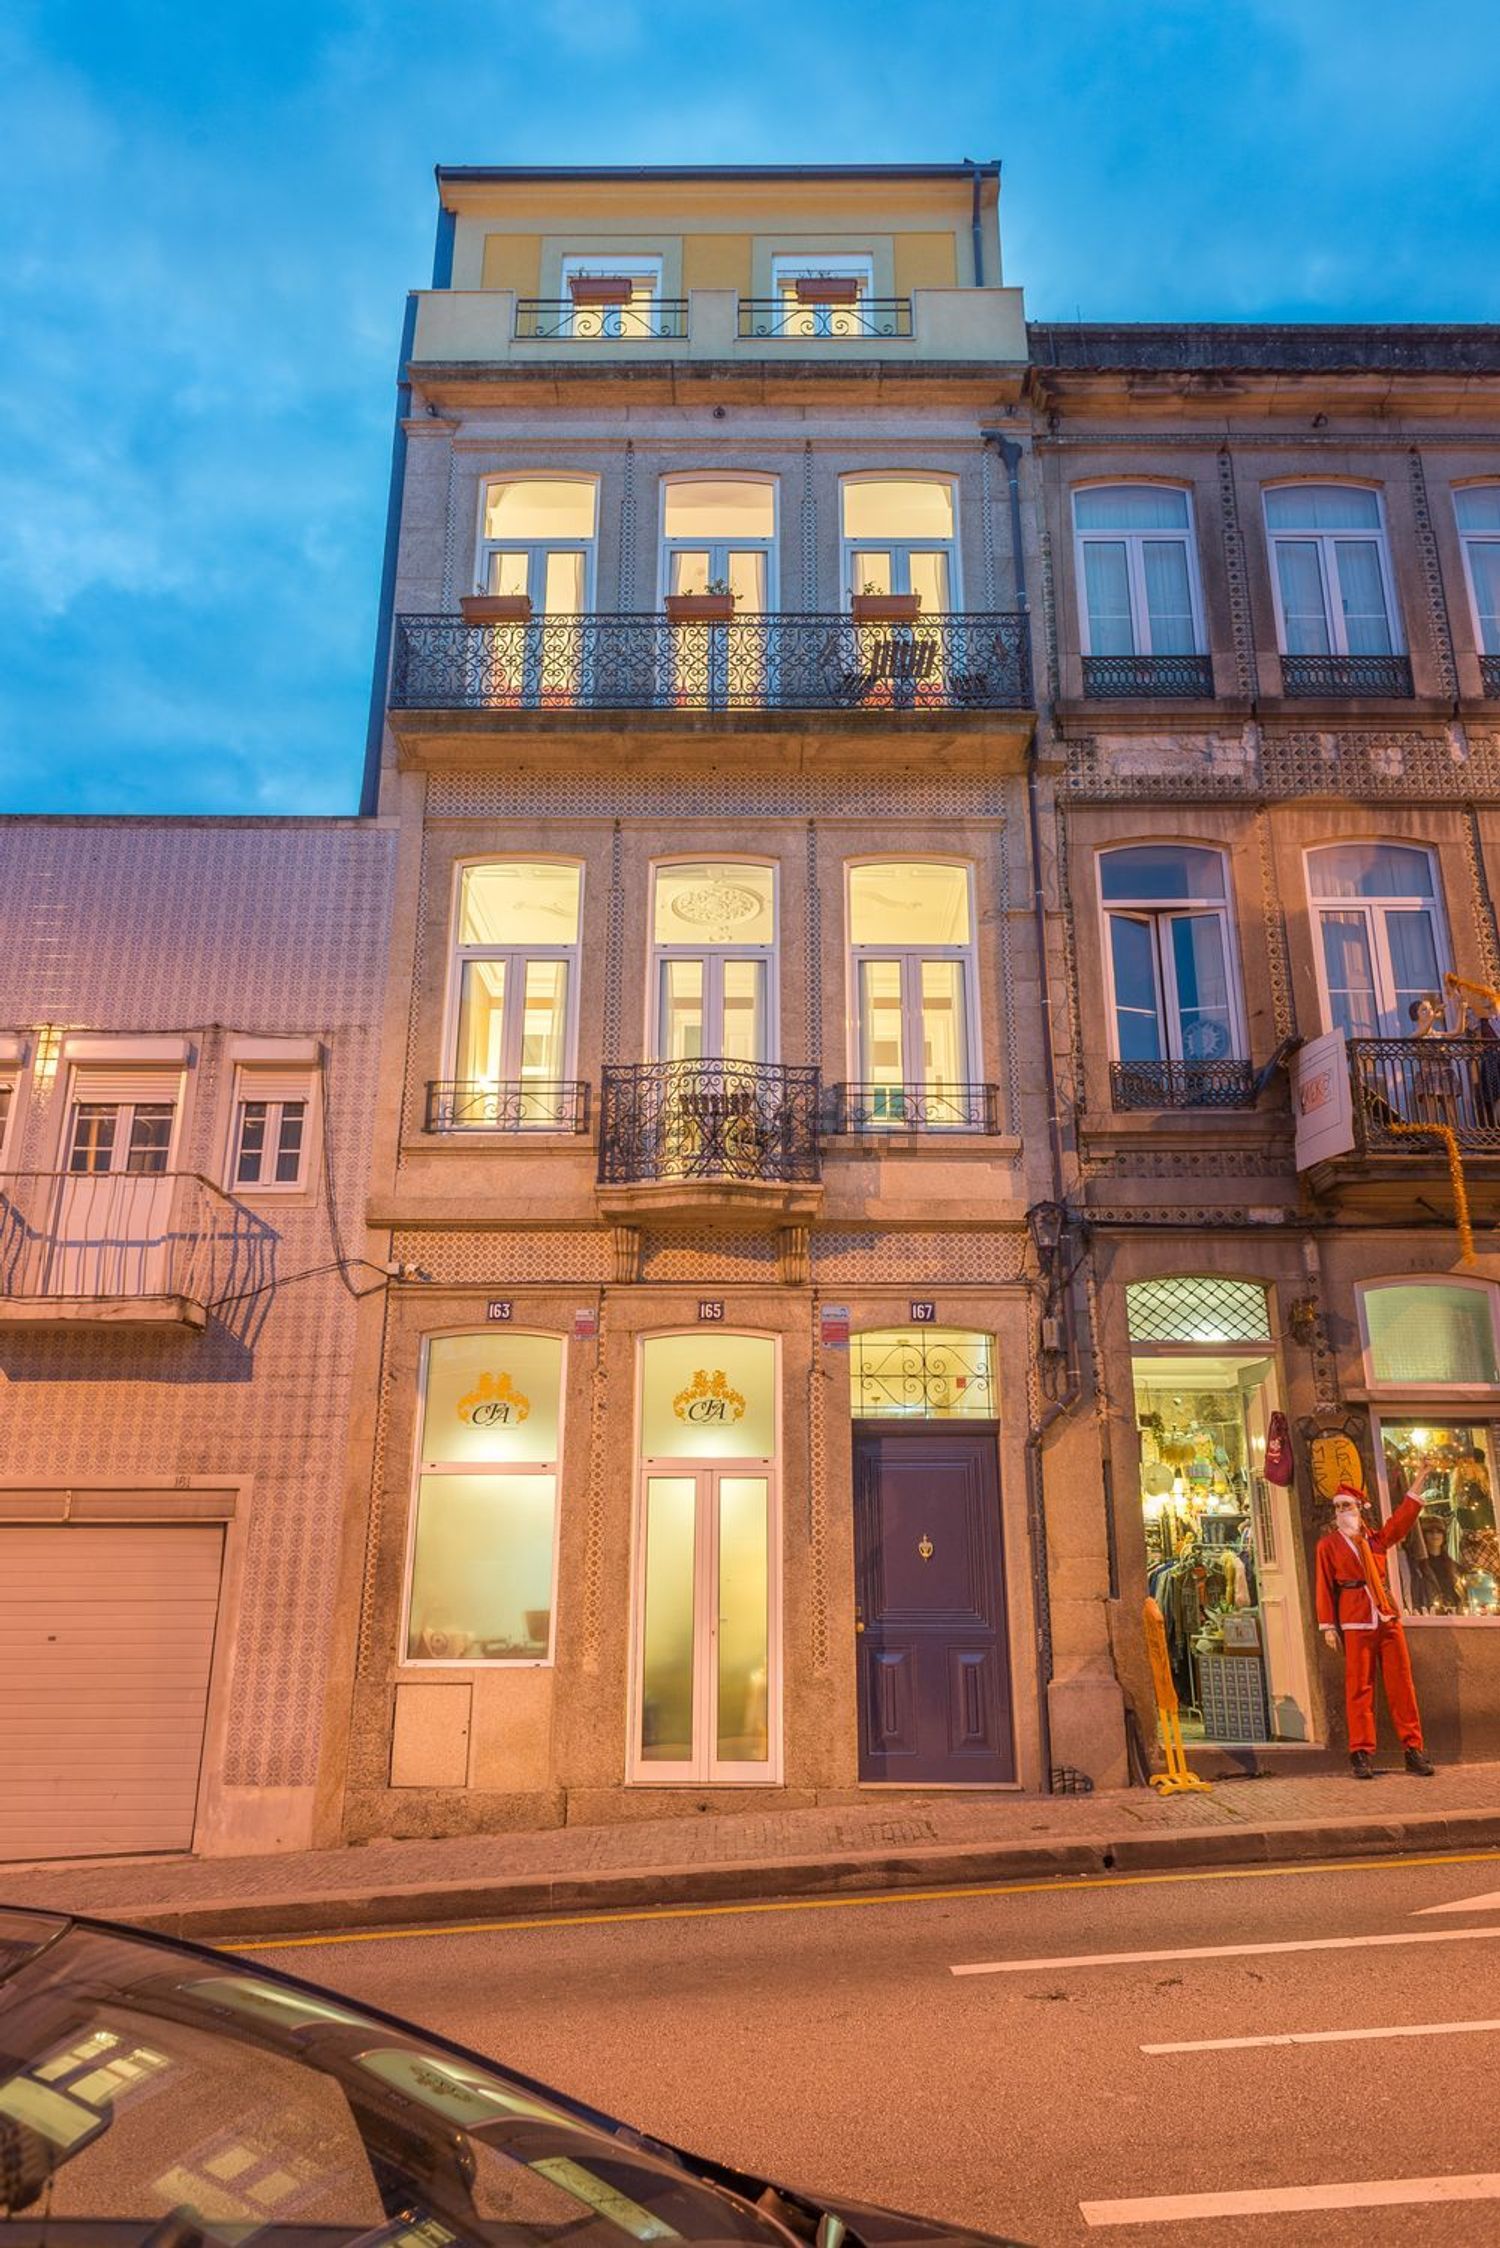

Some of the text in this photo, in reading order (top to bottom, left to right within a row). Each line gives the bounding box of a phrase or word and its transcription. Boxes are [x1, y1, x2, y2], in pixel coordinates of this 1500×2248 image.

[489, 1303, 511, 1319] 163
[700, 1303, 721, 1319] 165
[912, 1304, 933, 1320] 167
